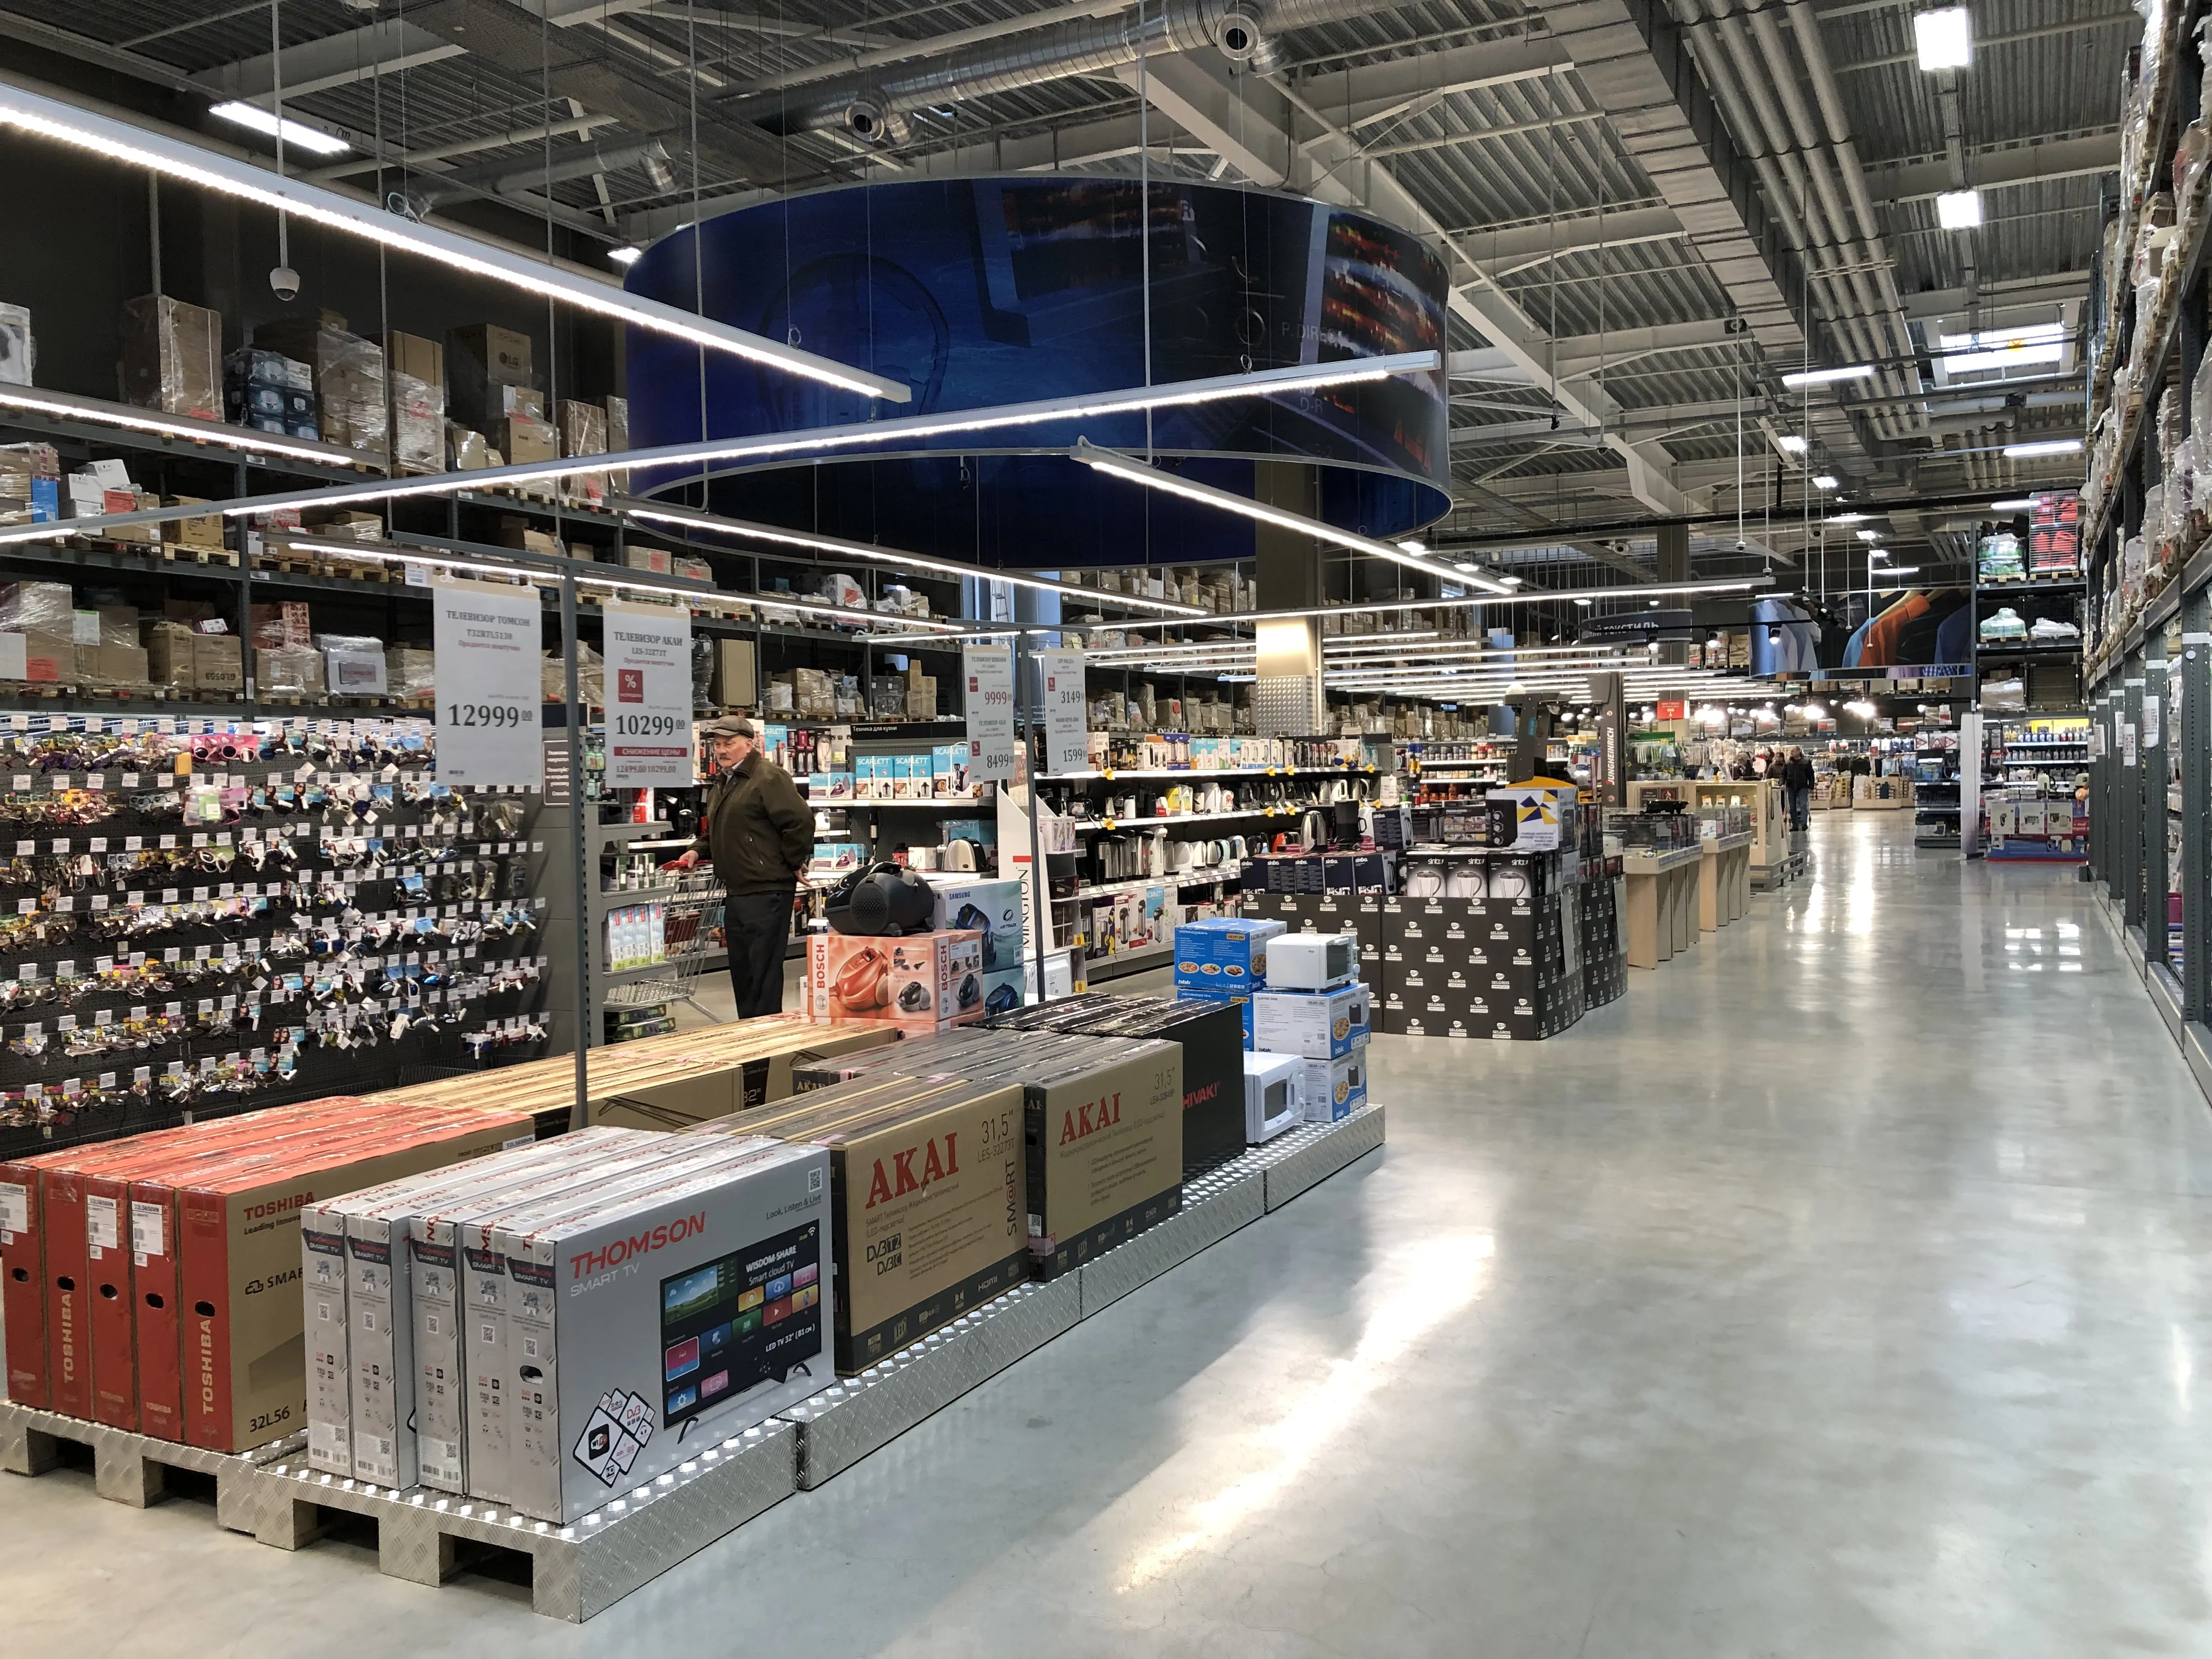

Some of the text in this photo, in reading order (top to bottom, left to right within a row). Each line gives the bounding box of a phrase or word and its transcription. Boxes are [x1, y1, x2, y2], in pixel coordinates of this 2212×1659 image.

[508, 356, 519, 366] LG
[446, 611, 531, 627] ТЕЛЕВИЗОР ТОМСОН
[613, 631, 661, 644] ТЕЛЕВИЗОР
[985, 692, 1007, 704] 9999
[1061, 691, 1080, 704] 3149
[448, 704, 519, 727] 12999
[616, 715, 685, 736] 10299 00
[987, 754, 1009, 769] 8499
[1064, 749, 1082, 763] 1599
[1606, 727, 1615, 785] JUNGHEINRICH
[949, 891, 970, 900] SAMSUNG
[1017, 869, 1029, 949] MINGTON
[816, 944, 825, 989] BOSCH
[1155, 1066, 1175, 1090] 31,5"
[1182, 1082, 1218, 1110] HIVAKI
[981, 1109, 1013, 1144] 31,5"
[1059, 1092, 1121, 1146] AKAI
[977, 1141, 1014, 1164] LES-32Z73T
[866, 1132, 958, 1210] AKAI
[244, 1191, 314, 1222] TOSHIBA
[766, 1208, 783, 1220] Look,
[785, 1200, 803, 1213] Listen
[810, 1194, 822, 1203] Live
[244, 1215, 301, 1235] Leading Innova
[866, 1214, 882, 1227] SMART
[309, 1242, 328, 1251] SMART
[354, 1251, 374, 1259] SMART
[571, 1212, 706, 1279] THOMSON
[418, 1254, 437, 1262] SMART
[472, 1261, 492, 1270] SMART
[267, 1267, 303, 1288] SMAR
[515, 1273, 537, 1283] SMART
[571, 1262, 640, 1297] SMART TV
[749, 1260, 794, 1286] Smart cloud TV
[63, 1293, 74, 1383] TOSHIBA
[895, 1321, 905, 1338] LED
[765, 1340, 776, 1352] LED
[776, 1335, 785, 1347] TV
[195, 1318, 214, 1415] TOSHIBA
[250, 1406, 290, 1433] 32L56
[627, 1405, 641, 1419] DVB
